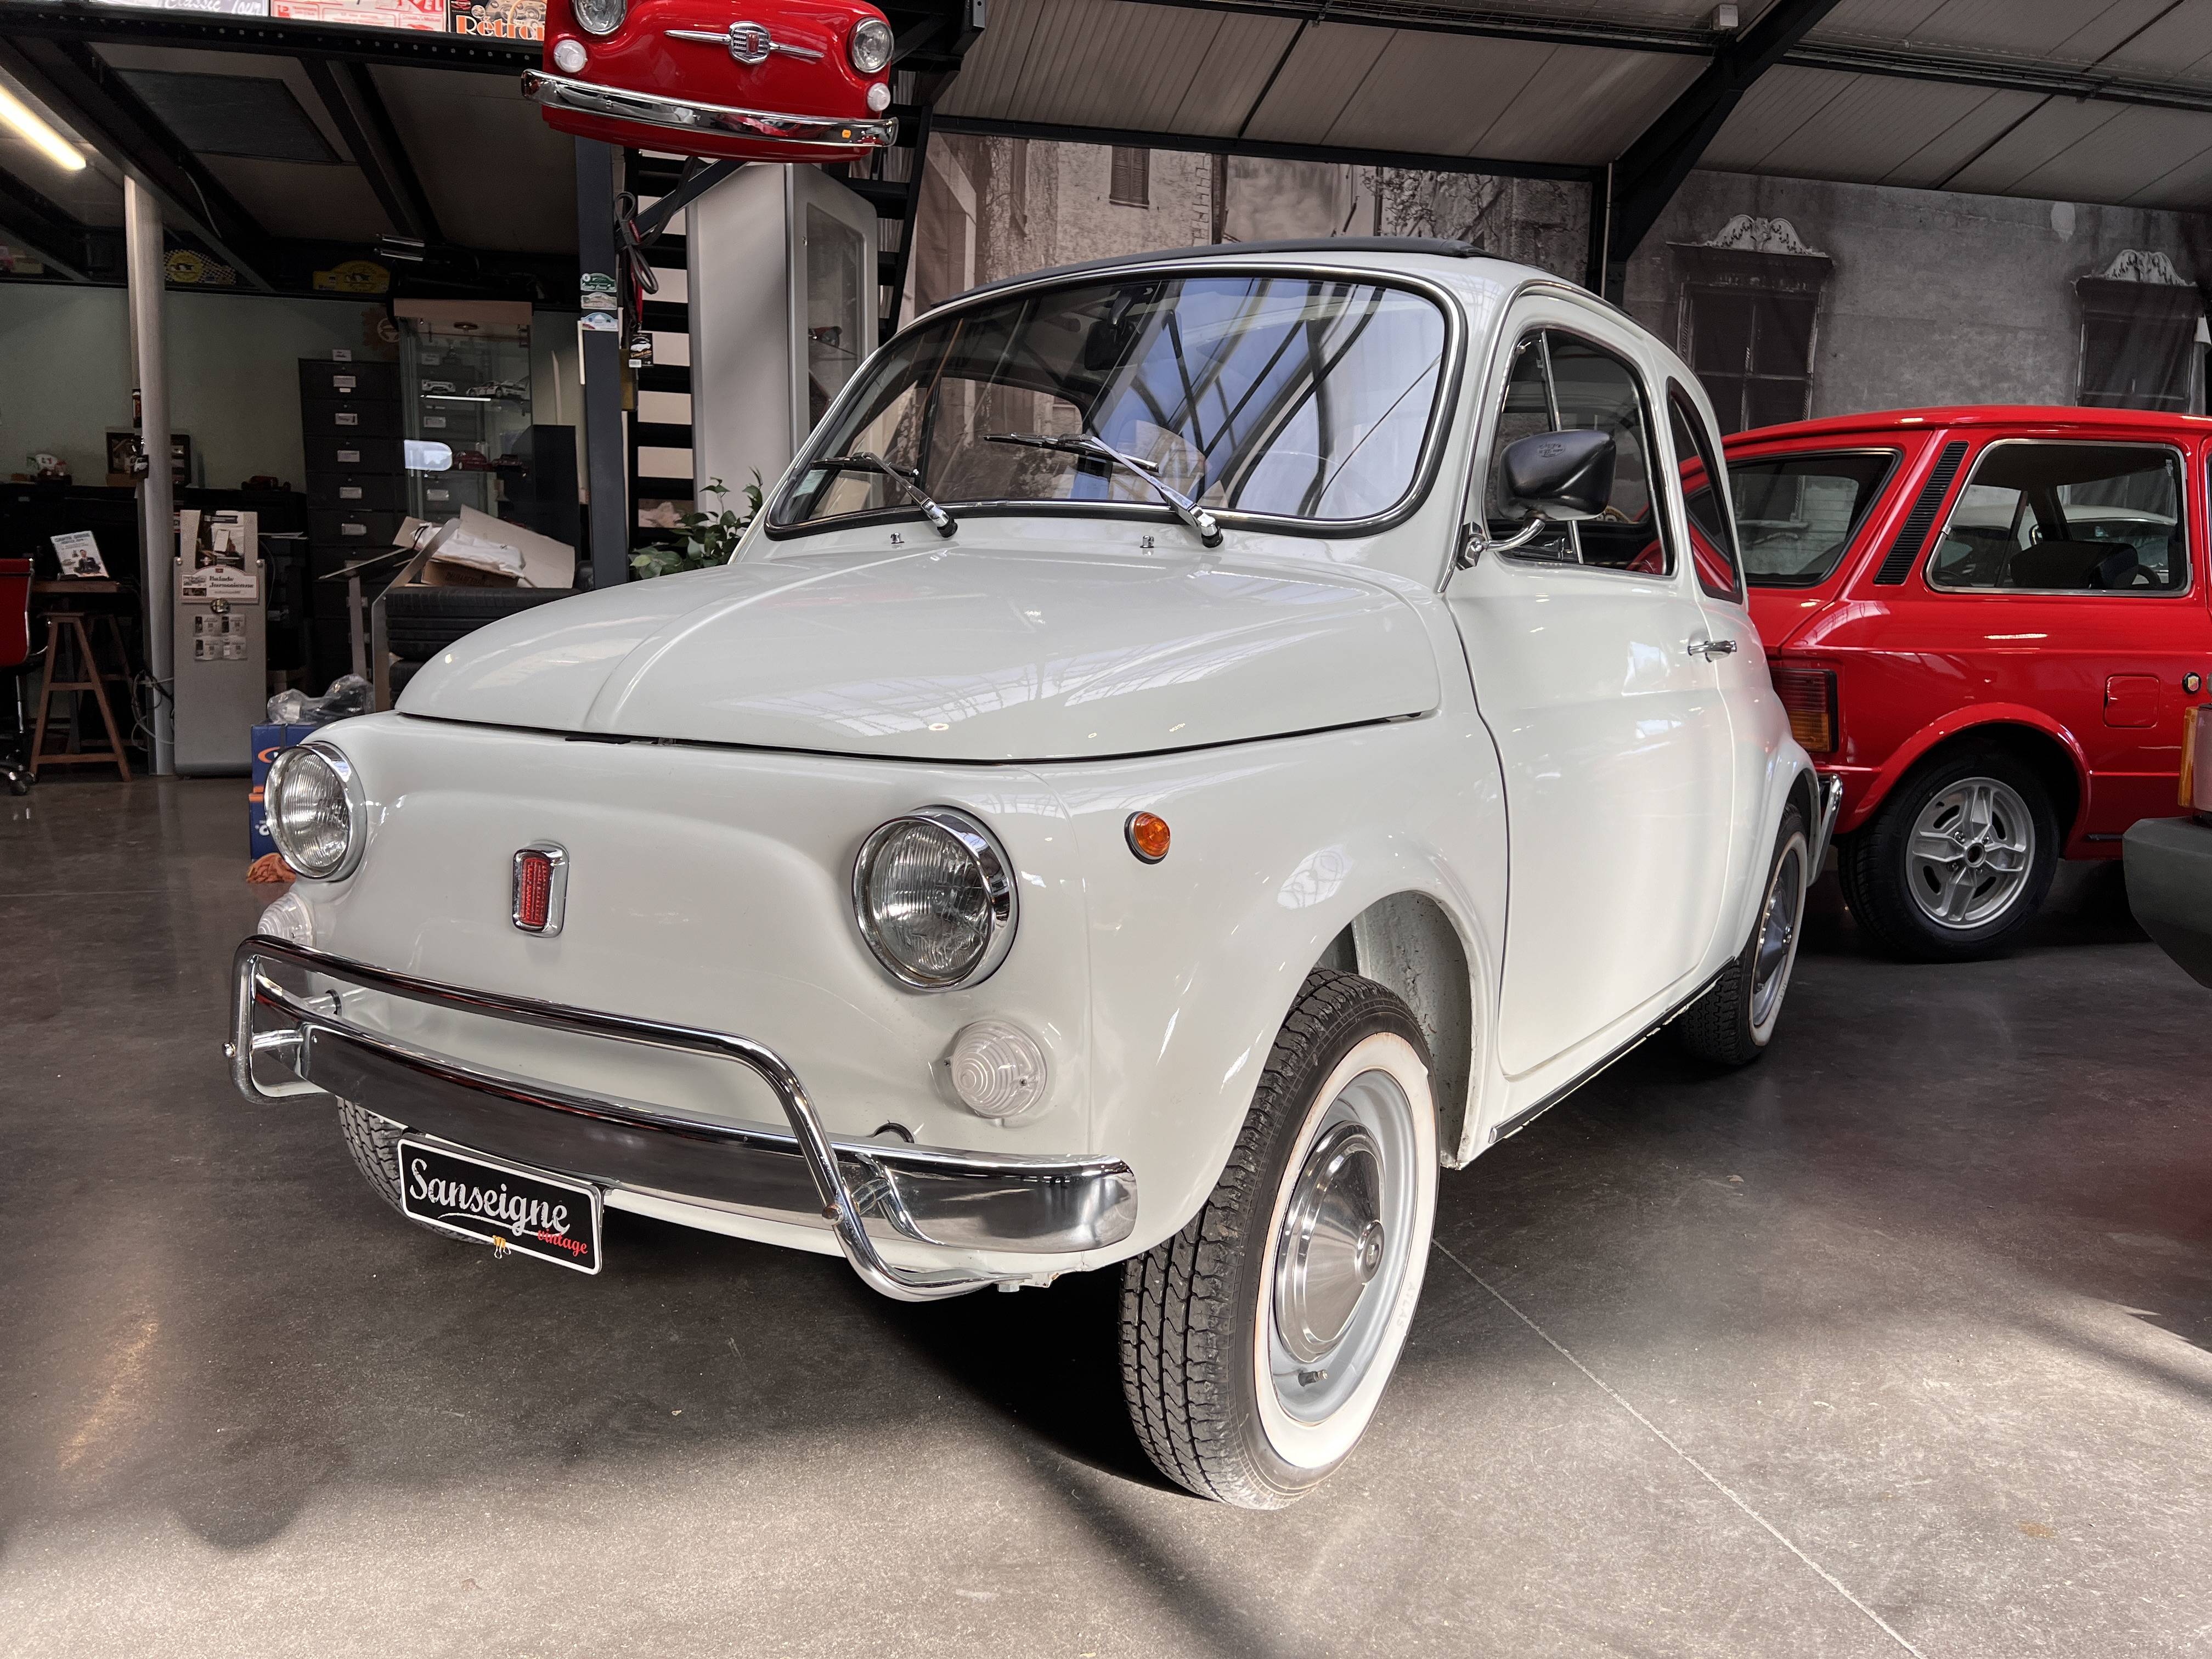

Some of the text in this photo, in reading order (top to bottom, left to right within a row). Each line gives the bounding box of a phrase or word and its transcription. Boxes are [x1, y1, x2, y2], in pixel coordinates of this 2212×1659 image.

[456, 15, 545, 41] Rétro
[409, 1158, 571, 1236] Sanseigne
[537, 1228, 588, 1257] vintage
